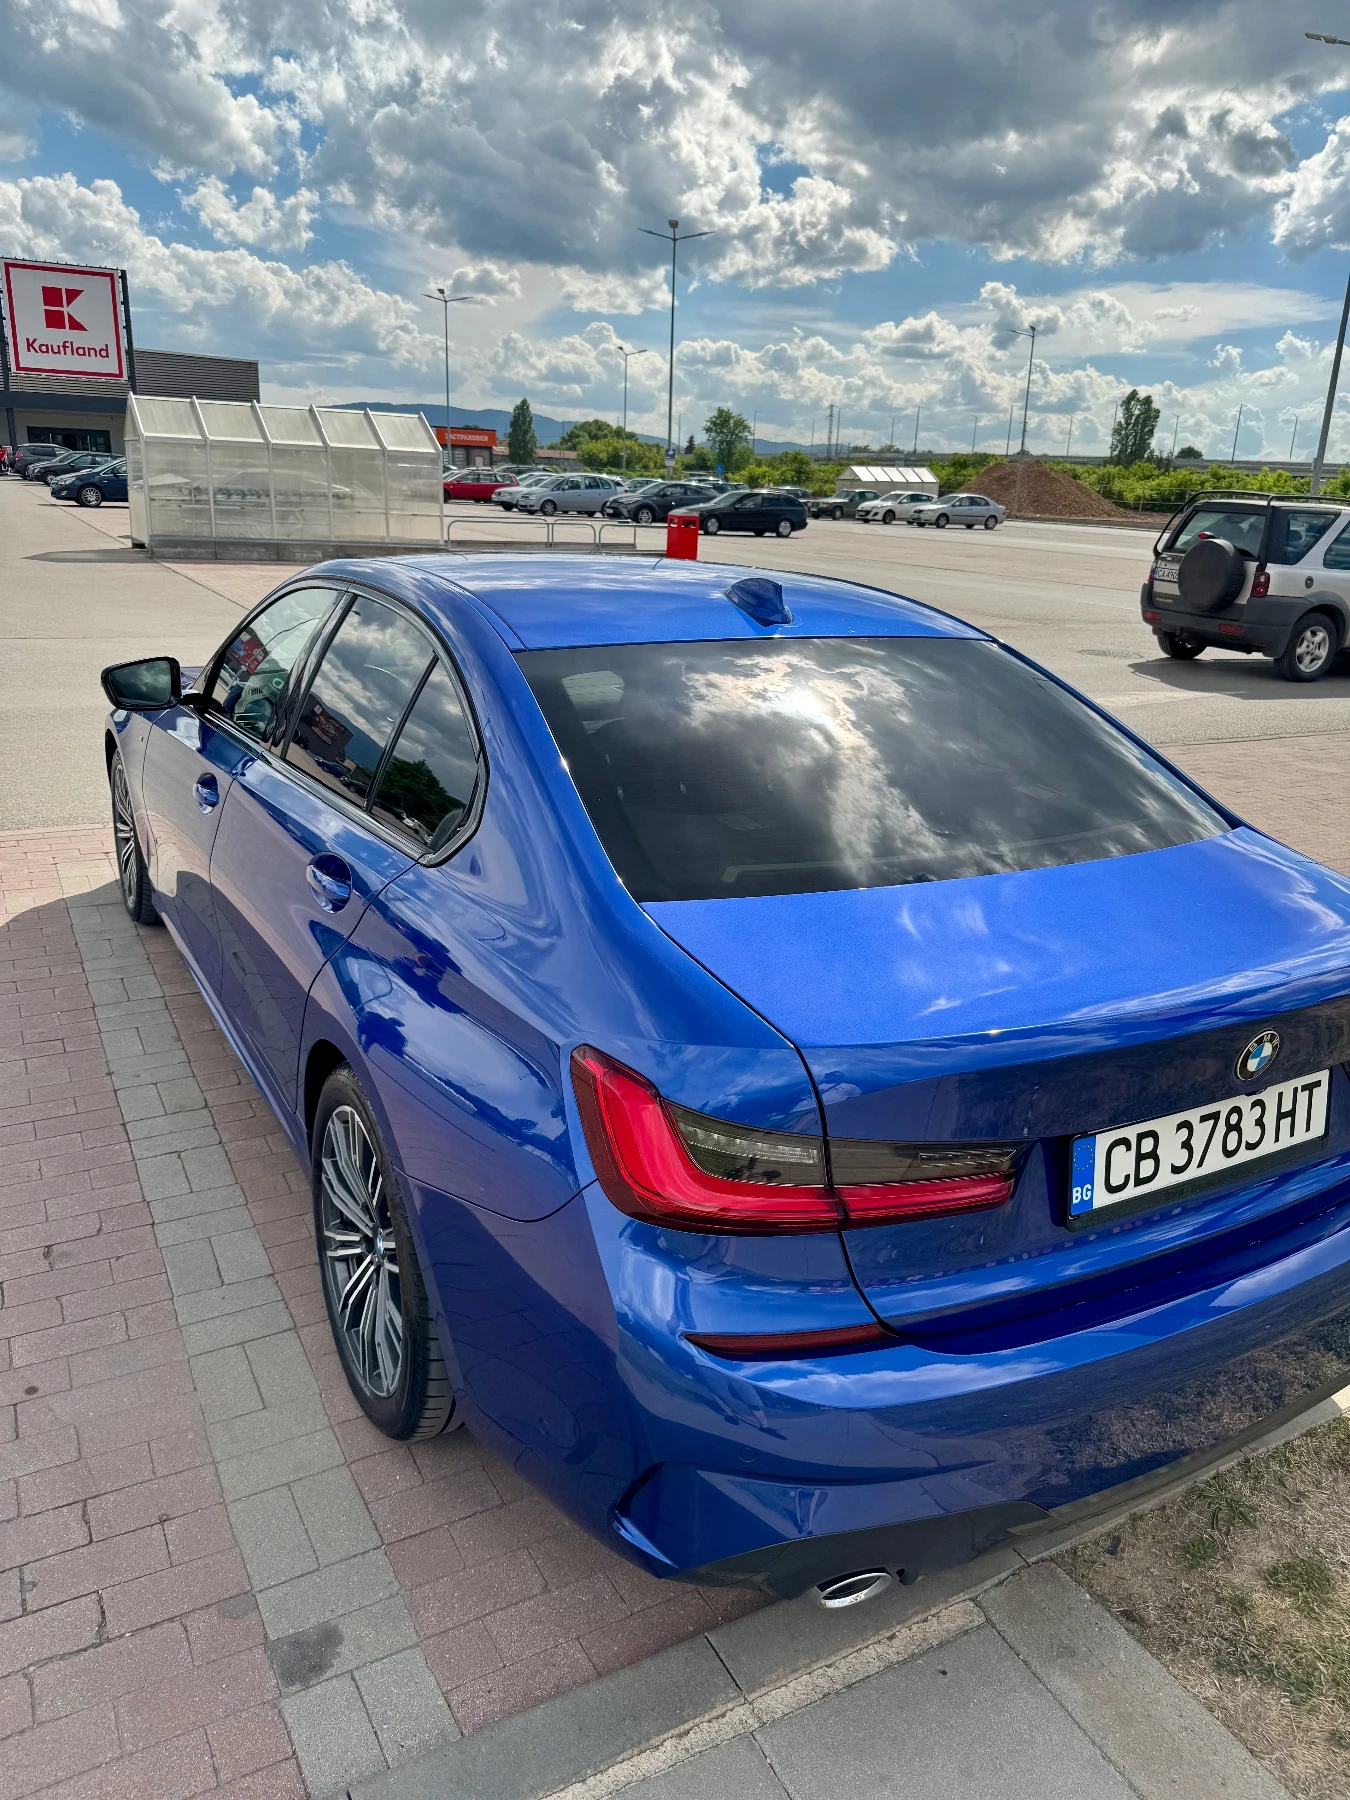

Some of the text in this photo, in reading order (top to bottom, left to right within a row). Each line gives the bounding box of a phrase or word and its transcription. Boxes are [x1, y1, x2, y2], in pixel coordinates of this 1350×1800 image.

[25, 337, 110, 359] Kaufland
[1249, 1033, 1279, 1052] BMW
[1104, 1079, 1322, 1194] CB 3783 HT
[1072, 1183, 1092, 1204] BG
